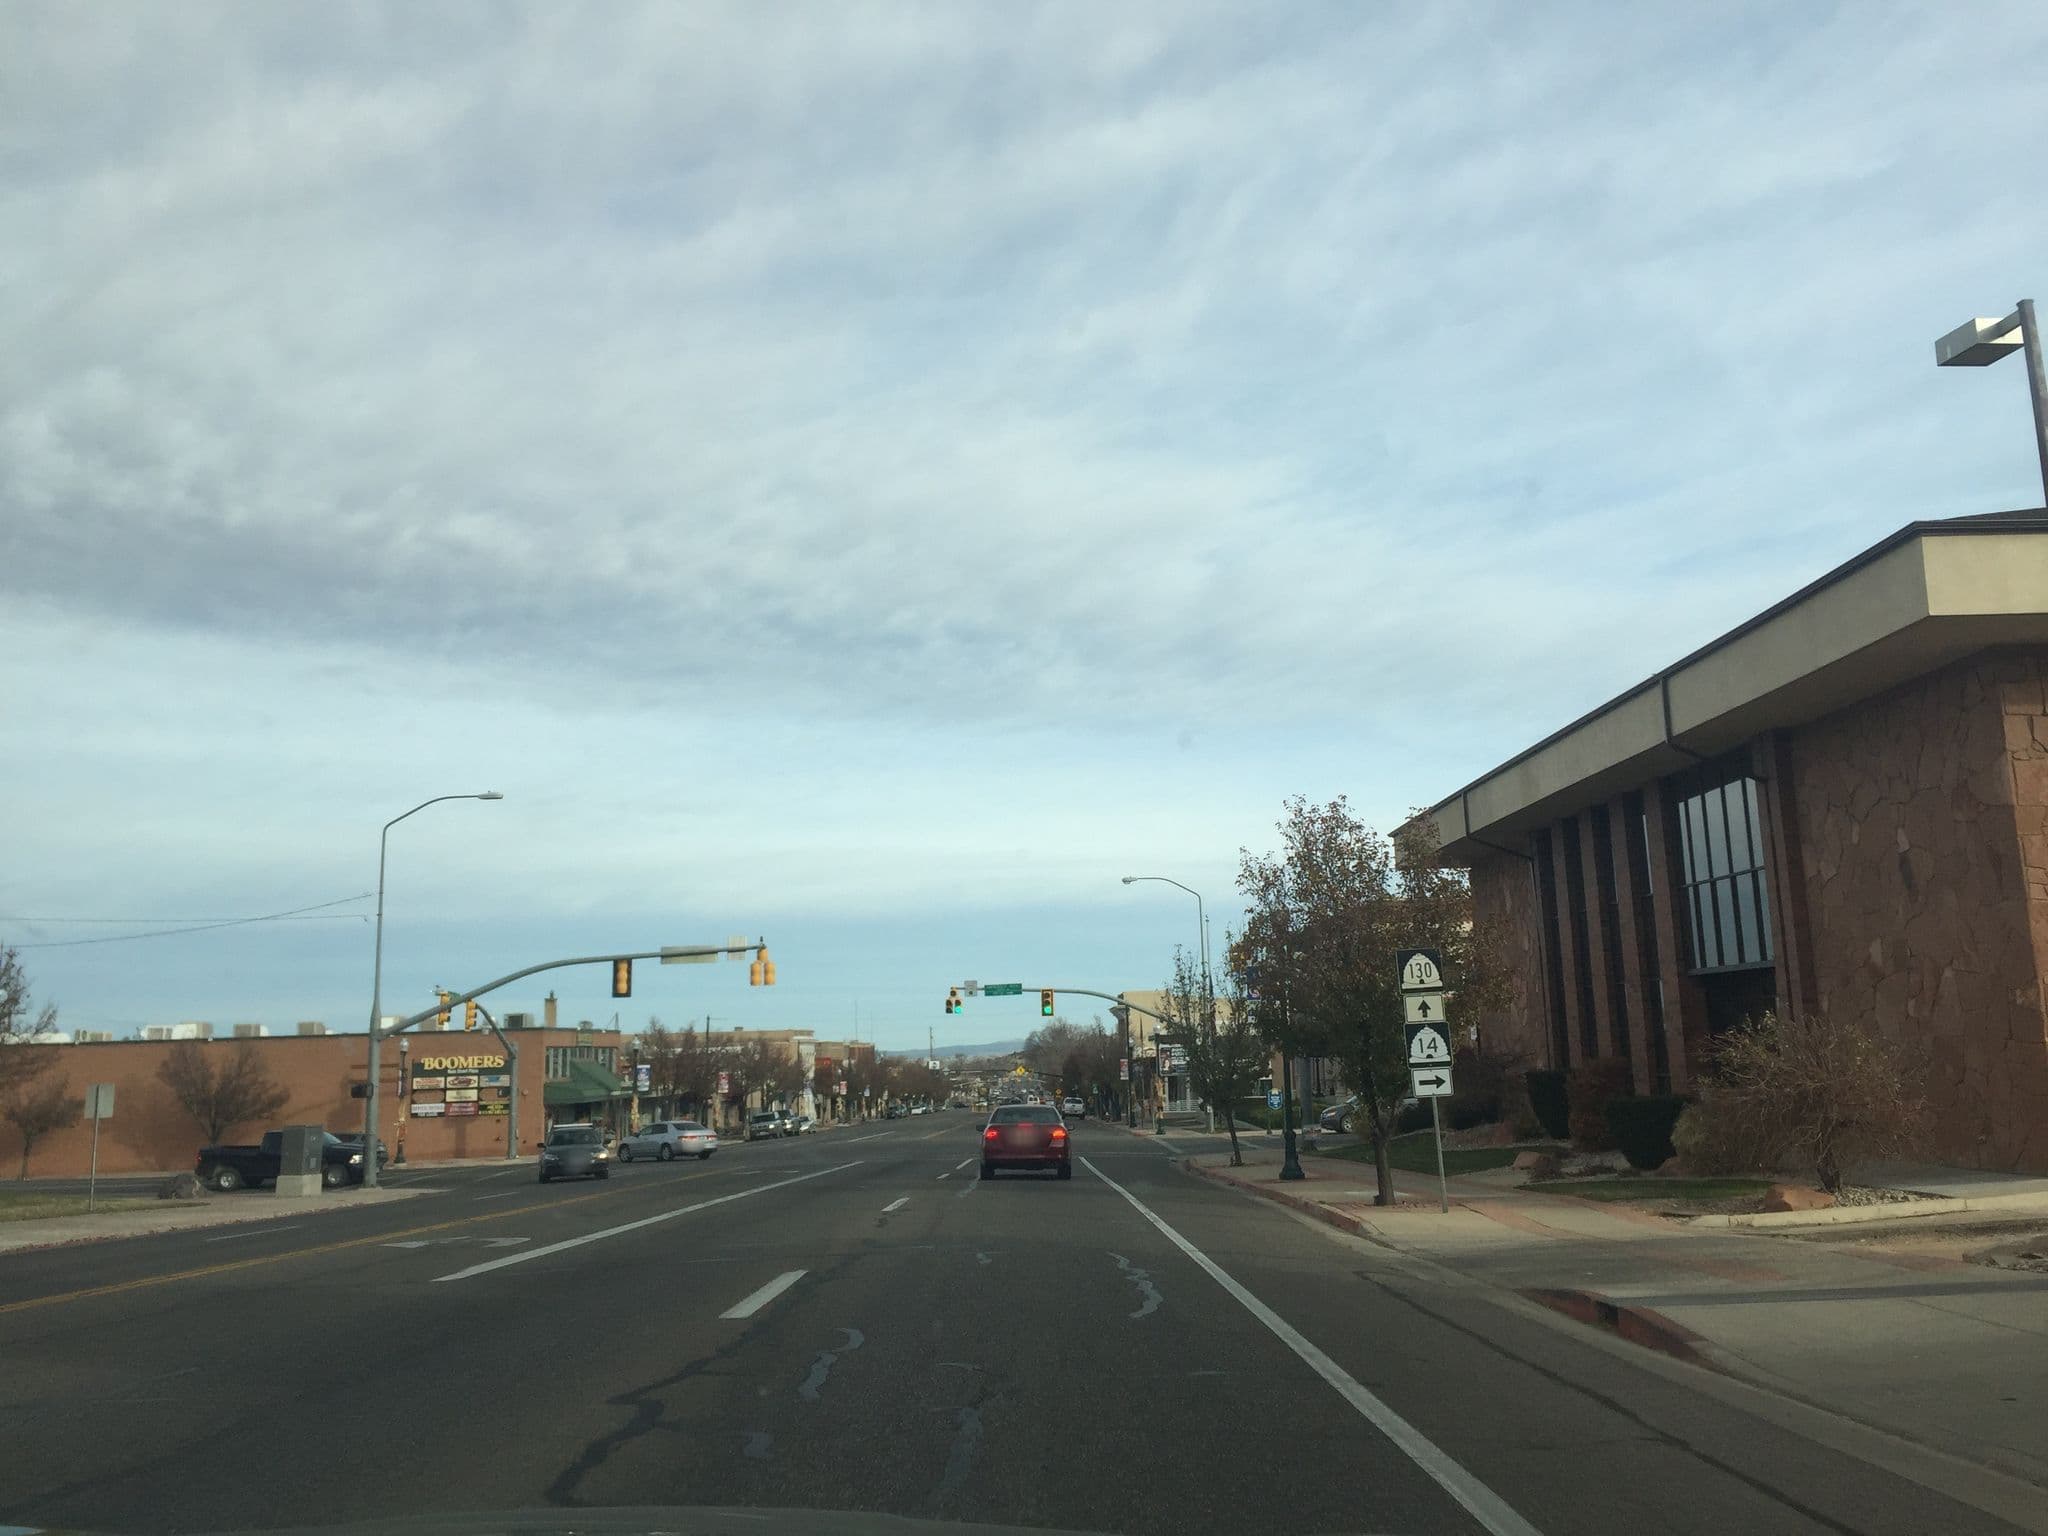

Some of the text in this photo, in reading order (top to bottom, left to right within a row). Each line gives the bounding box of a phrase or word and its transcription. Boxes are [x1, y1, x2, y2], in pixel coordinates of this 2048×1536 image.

[1410, 962, 1432, 979] 130
[1419, 1038, 1438, 1053] 14
[422, 1056, 505, 1070] BOOMERS
